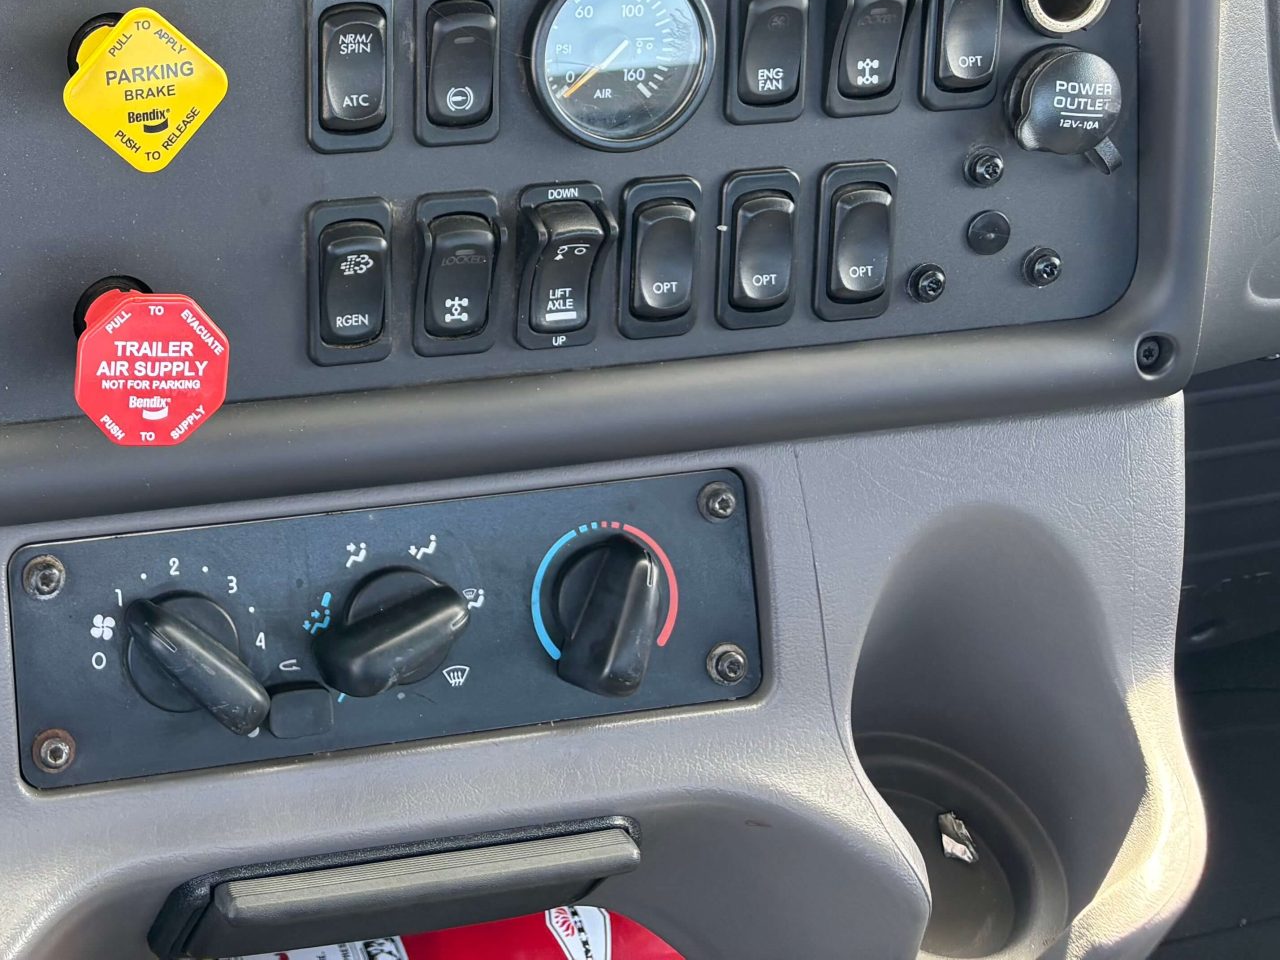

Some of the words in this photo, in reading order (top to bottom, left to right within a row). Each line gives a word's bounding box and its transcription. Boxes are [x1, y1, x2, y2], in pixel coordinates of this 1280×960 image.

[575, 4, 594, 19] 60
[622, 3, 645, 18] 100
[108, 32, 132, 57] PULL
[134, 20, 151, 31] TO
[153, 28, 187, 55] APPLY
[338, 33, 373, 45] NRM/
[339, 42, 372, 55] SPIN
[556, 44, 572, 55] PSI
[958, 55, 983, 69] OPT
[105, 60, 194, 86] PARKING
[565, 71, 575, 83] 0
[623, 68, 646, 82] 160
[758, 67, 784, 81] ENG
[758, 78, 784, 91] FAN
[1055, 80, 1112, 96] POWER
[124, 84, 176, 101] BRAKE
[593, 88, 612, 99] AIR
[342, 94, 369, 107] ATC
[1053, 96, 1112, 111] OUTLET
[1059, 118, 1099, 130] 12V-10A
[114, 129, 142, 154] PUSH
[145, 150, 161, 161] TO
[161, 106, 201, 151] RELEASE
[548, 187, 579, 199] DOWN
[848, 265, 874, 279] OPT
[652, 280, 679, 294] OPT
[752, 274, 778, 287] OPT
[549, 287, 572, 300] LIFT
[547, 298, 574, 311] AXLE
[335, 313, 369, 327] RGEN
[105, 310, 132, 334] PULL
[148, 305, 165, 315] TO
[180, 309, 225, 356] EVACUATE
[552, 335, 567, 346] UP
[114, 341, 194, 357] TRAILER
[96, 361, 130, 377] AIR
[133, 360, 209, 377] SUPPLY
[101, 379, 126, 390] NOT
[127, 379, 151, 390] FOR
[152, 379, 201, 390] PARKING
[100, 414, 126, 440] PUSH
[140, 431, 156, 441] TO
[170, 404, 206, 440] SUPPLY
[169, 558, 180, 576] 2
[227, 576, 238, 594] 3
[114, 588, 123, 607] 1
[255, 631, 266, 650] 4
